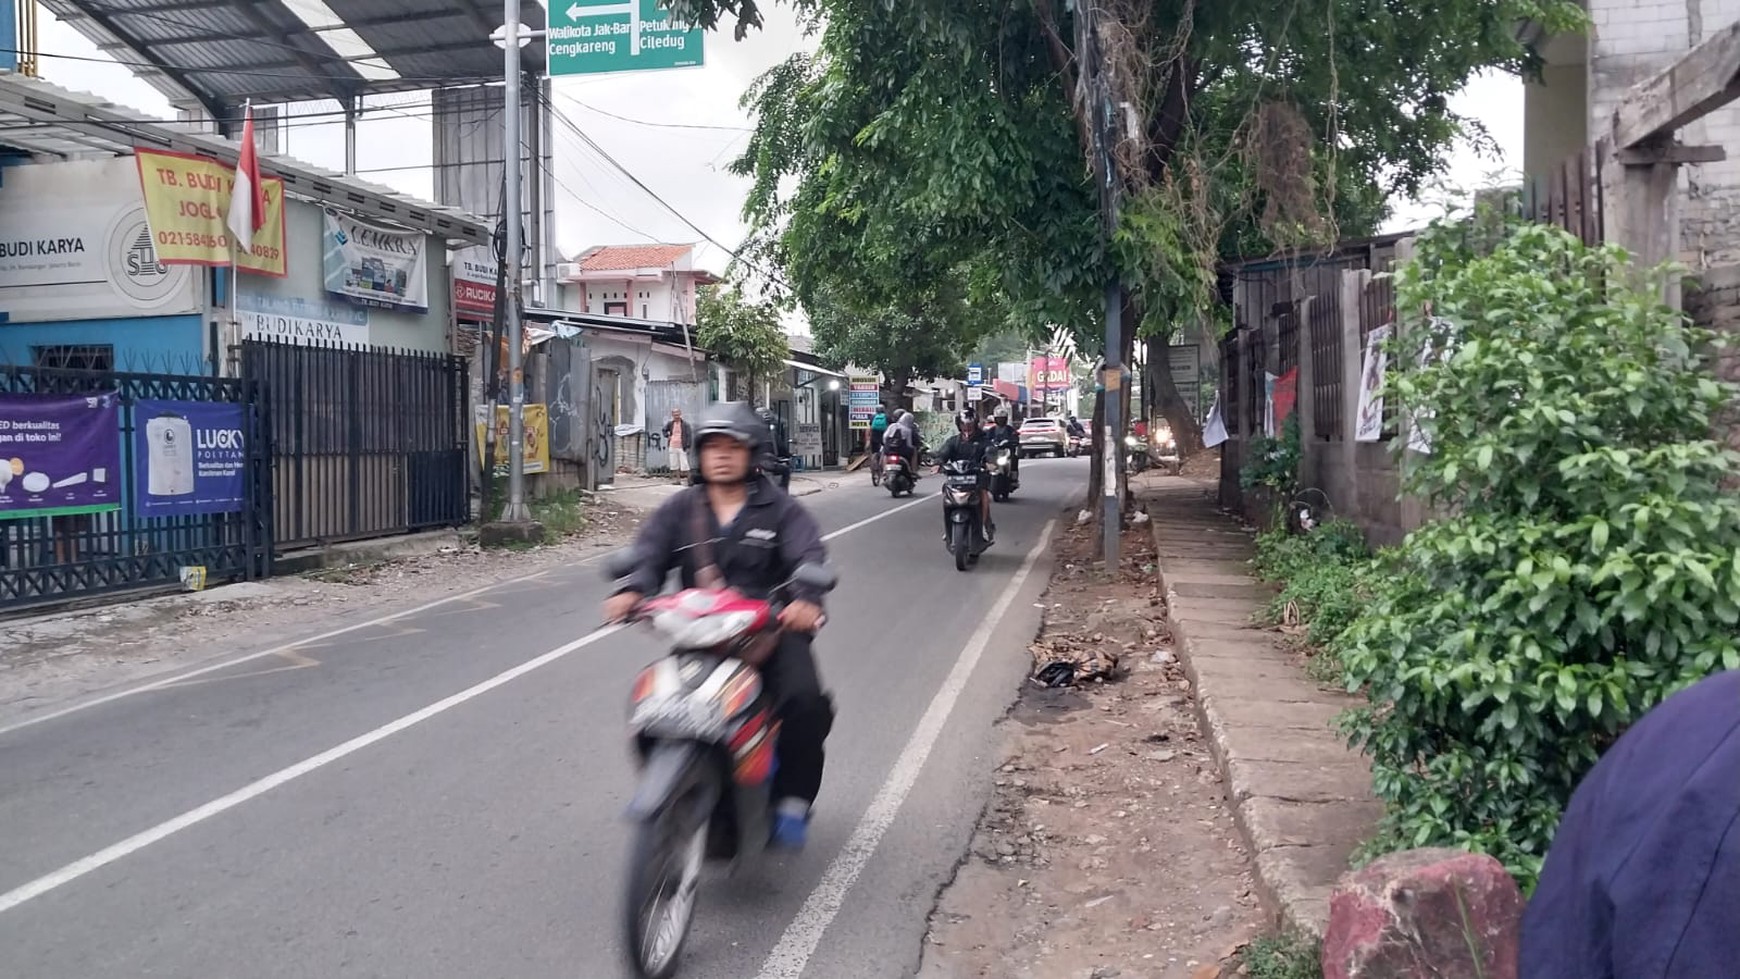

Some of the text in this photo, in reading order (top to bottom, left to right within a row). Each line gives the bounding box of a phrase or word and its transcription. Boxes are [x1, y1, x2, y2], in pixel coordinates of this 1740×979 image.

[550, 26, 592, 40] Walikota
[550, 40, 616, 57] Cengkareng
[640, 34, 685, 49] Ciledug
[156, 168, 182, 187] TB.
[186, 172, 222, 193] BUDI
[0, 238, 85, 258] BUDI KARYA
[465, 286, 497, 302] RUCIKA
[12, 420, 60, 430] berkualitas
[14, 432, 24, 442] di
[25, 432, 47, 442] toko
